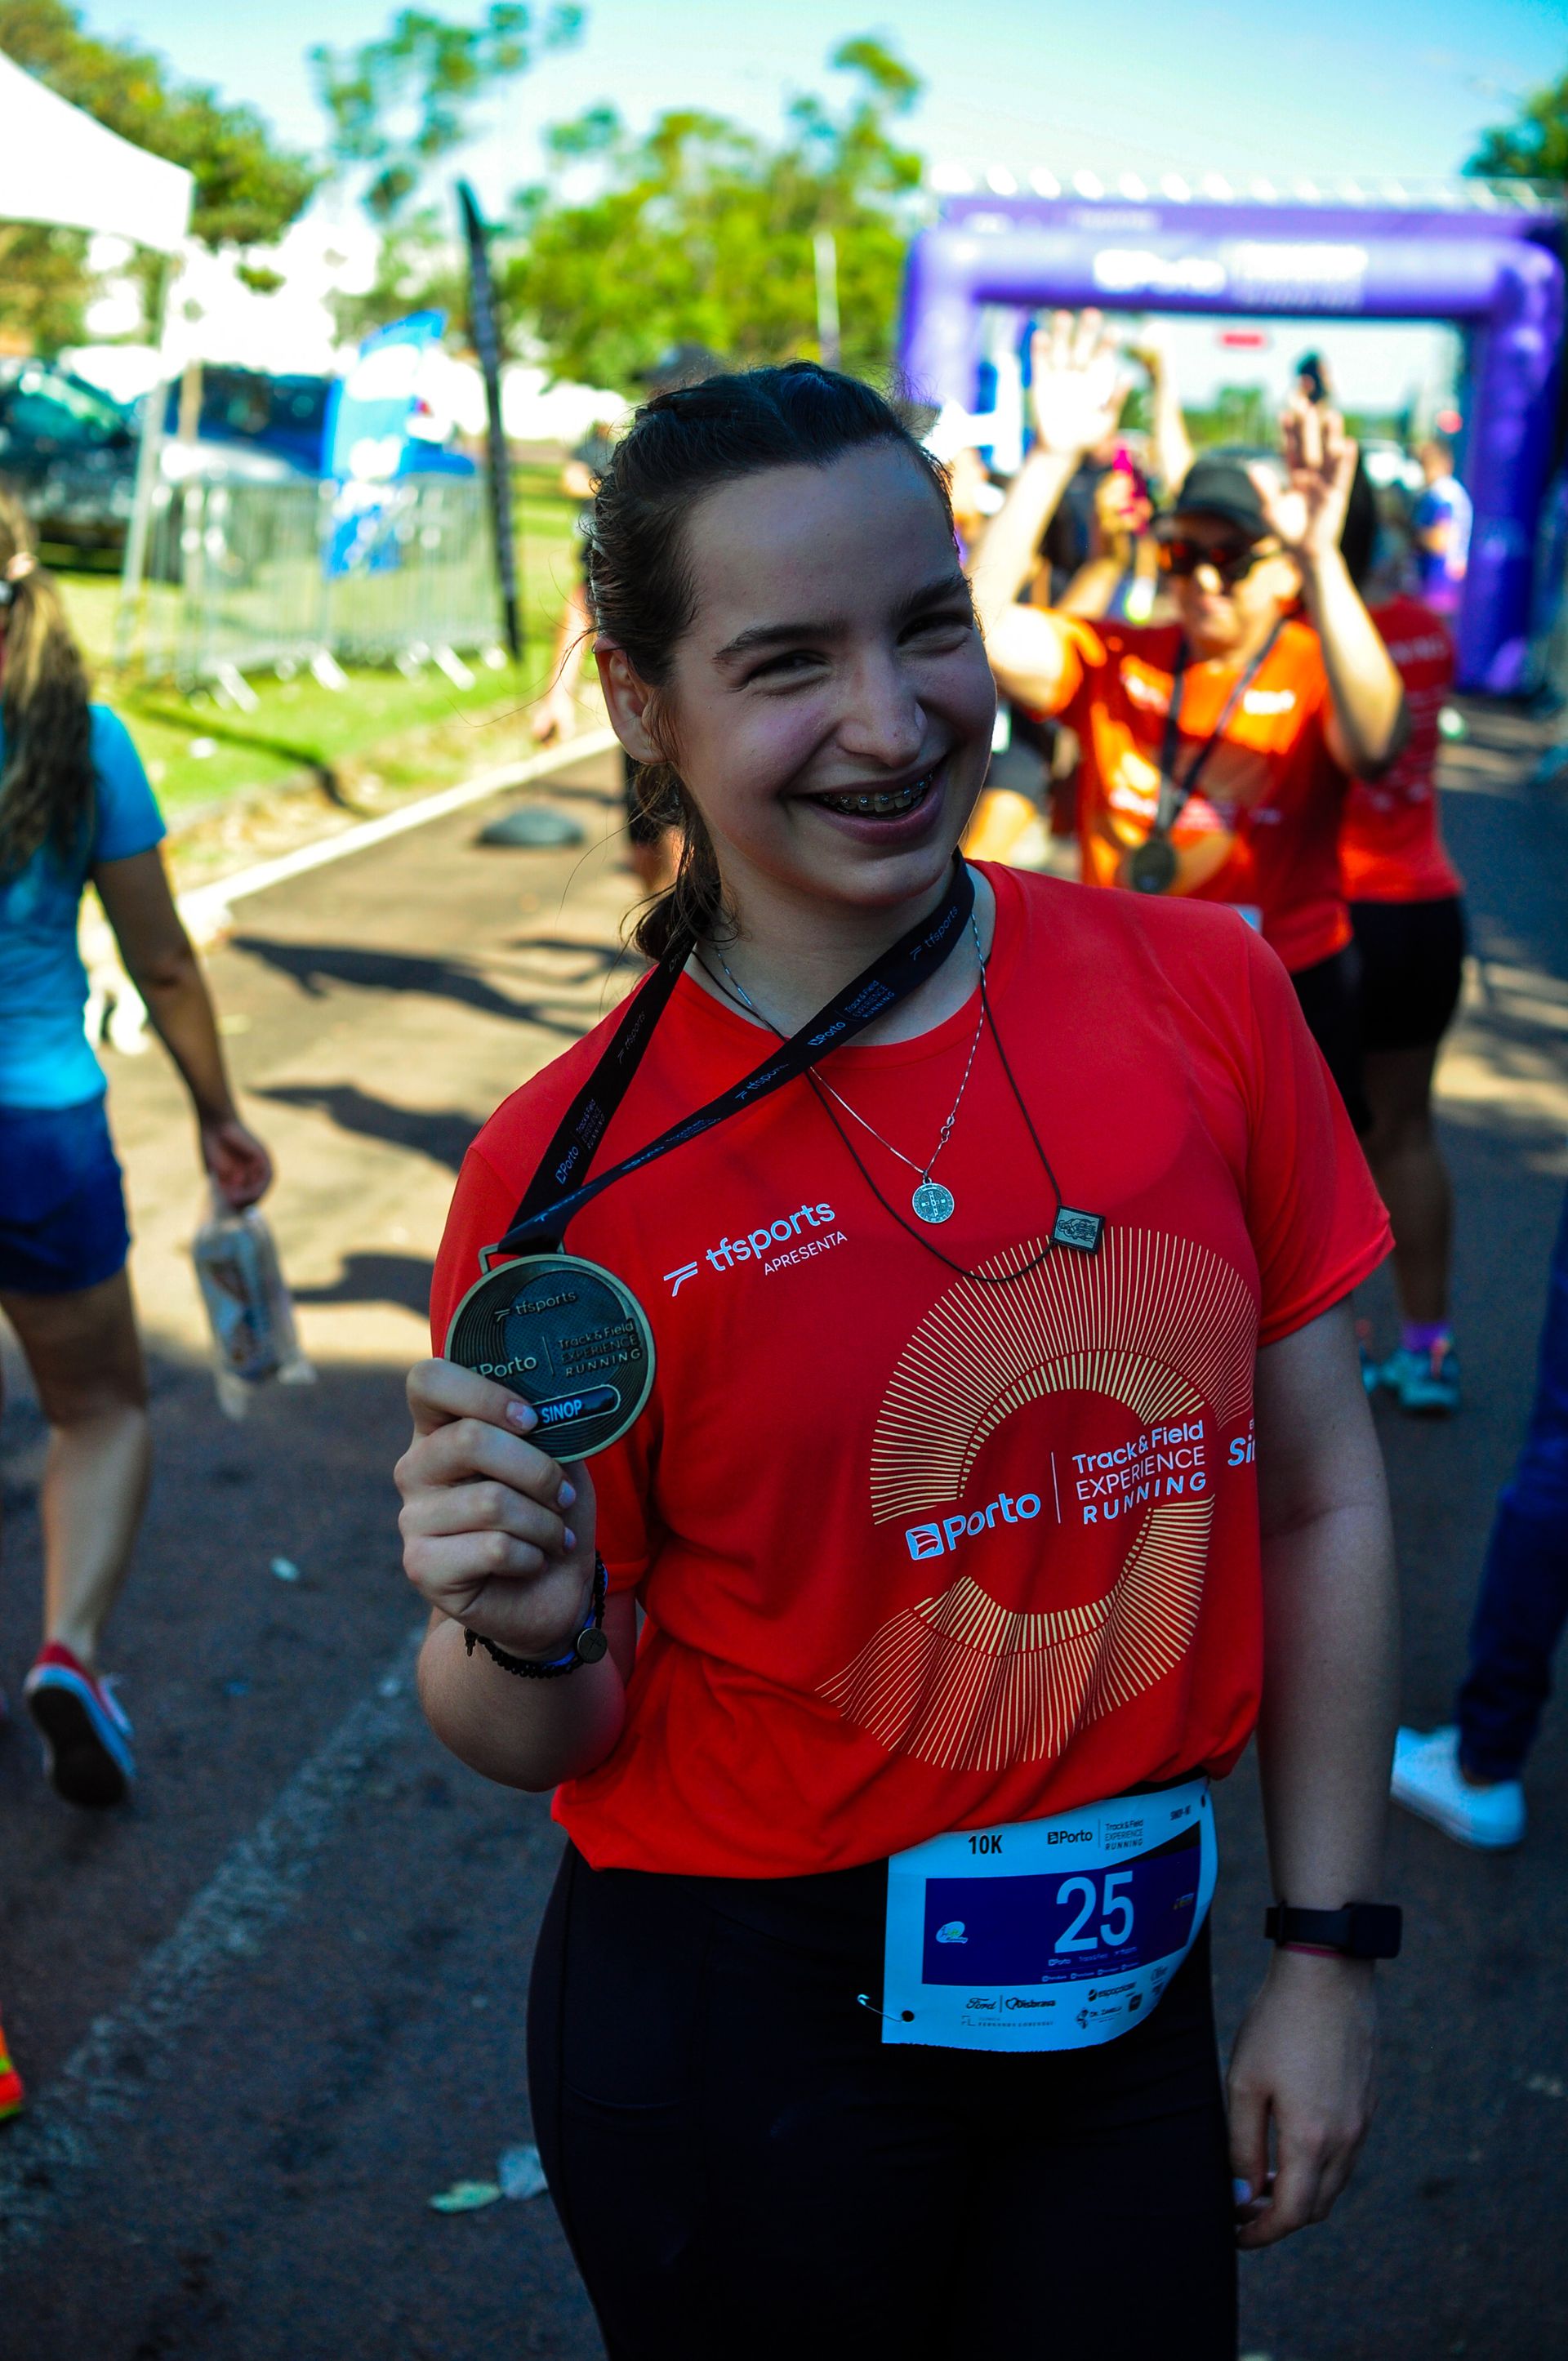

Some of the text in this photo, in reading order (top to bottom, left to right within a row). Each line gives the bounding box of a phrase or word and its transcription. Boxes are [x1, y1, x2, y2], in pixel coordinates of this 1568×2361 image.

[924, 906, 959, 947] tfsports
[817, 1021, 846, 1045] Porto
[560, 1145, 580, 1175] Porto
[706, 1203, 835, 1272] tfsports
[764, 1231, 848, 1276] APRESENTA
[515, 1290, 577, 1316] tfsports
[562, 1334, 638, 1364] EXPERIENCE
[566, 1348, 640, 1377] RUNNING
[479, 1356, 537, 1378] Porto
[541, 1399, 582, 1423] SINOP
[1227, 1434, 1255, 1467] Si
[1076, 1446, 1205, 1501] EXPERIENCE
[1083, 1471, 1207, 1525] RUNNING
[942, 1492, 1041, 1552] Porto
[968, 1835, 1003, 1855] 10K
[1060, 1830, 1093, 1842] Porto
[1105, 1838, 1143, 1850] RUNNING
[1054, 1870, 1134, 1953] 25
[966, 1998, 996, 2010] Ford
